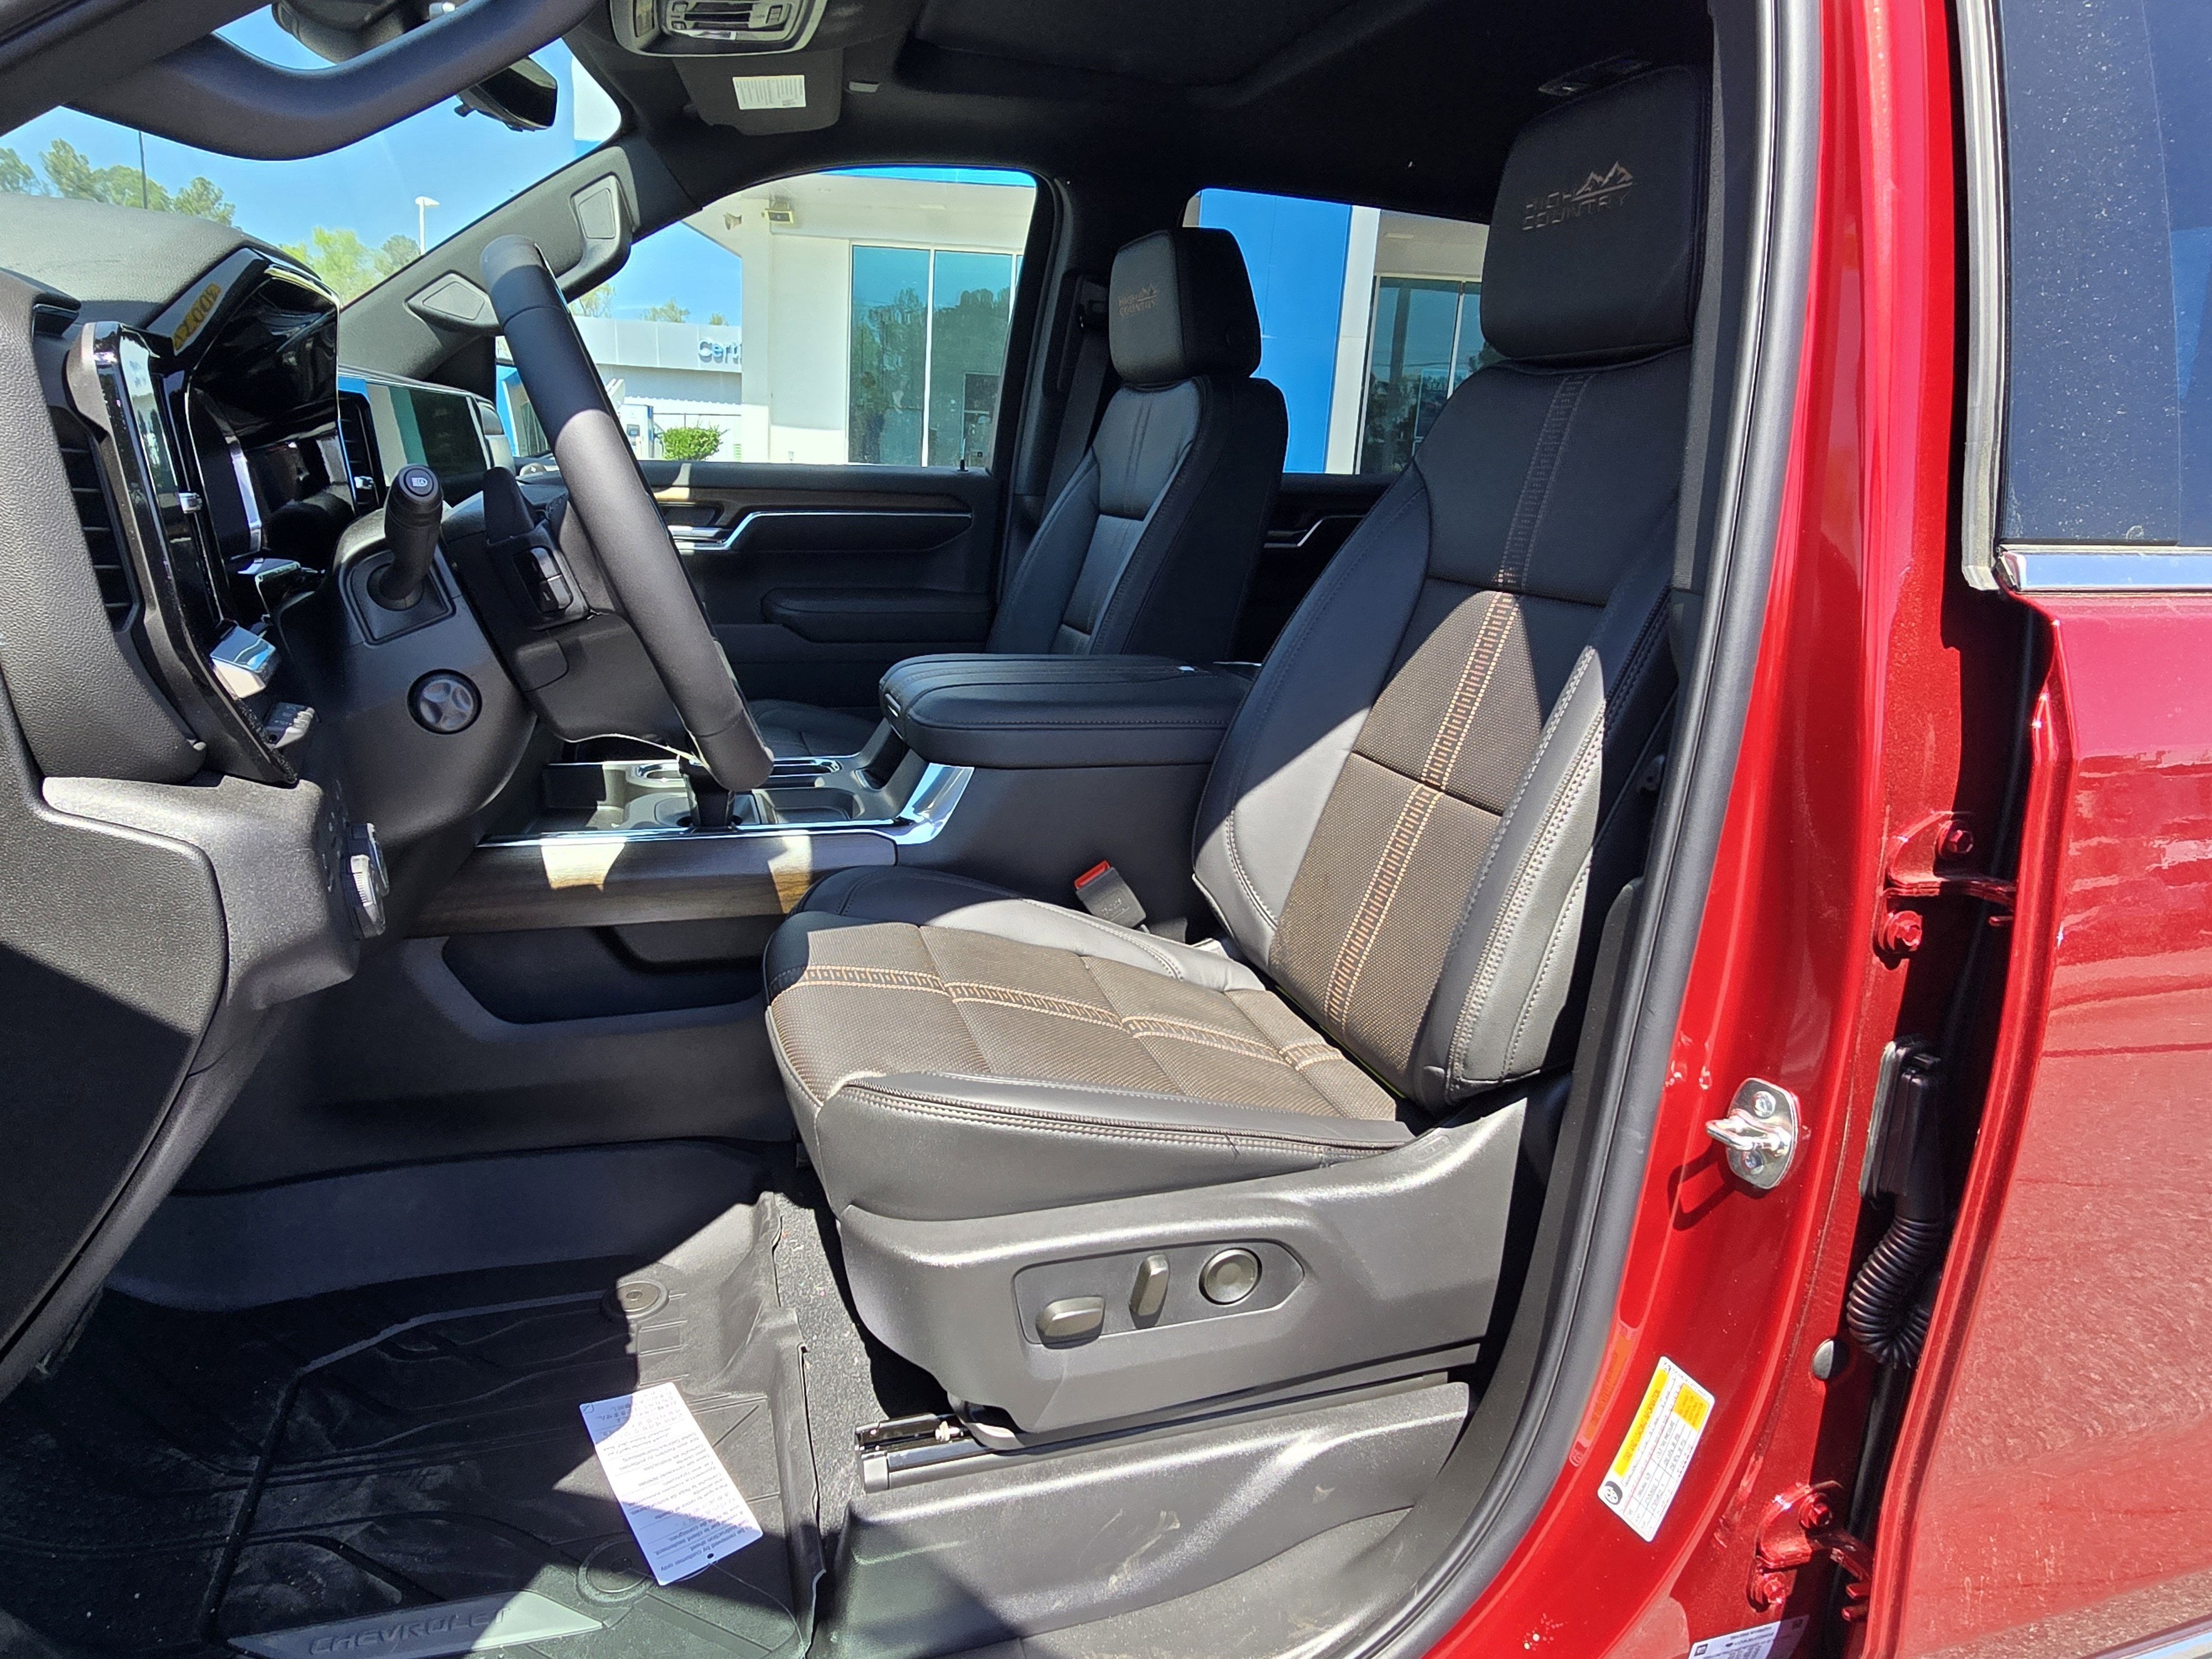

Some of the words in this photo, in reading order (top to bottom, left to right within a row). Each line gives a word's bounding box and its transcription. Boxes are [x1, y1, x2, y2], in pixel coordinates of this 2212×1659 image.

[709, 1521, 721, 1530] par
[687, 1531, 703, 1541] client
[707, 1525, 737, 1542] instruction
[711, 1533, 736, 1547] removed
[701, 1545, 711, 1553] by
[675, 1550, 702, 1566] customer
[309, 1608, 512, 1655] CHEVROLET
